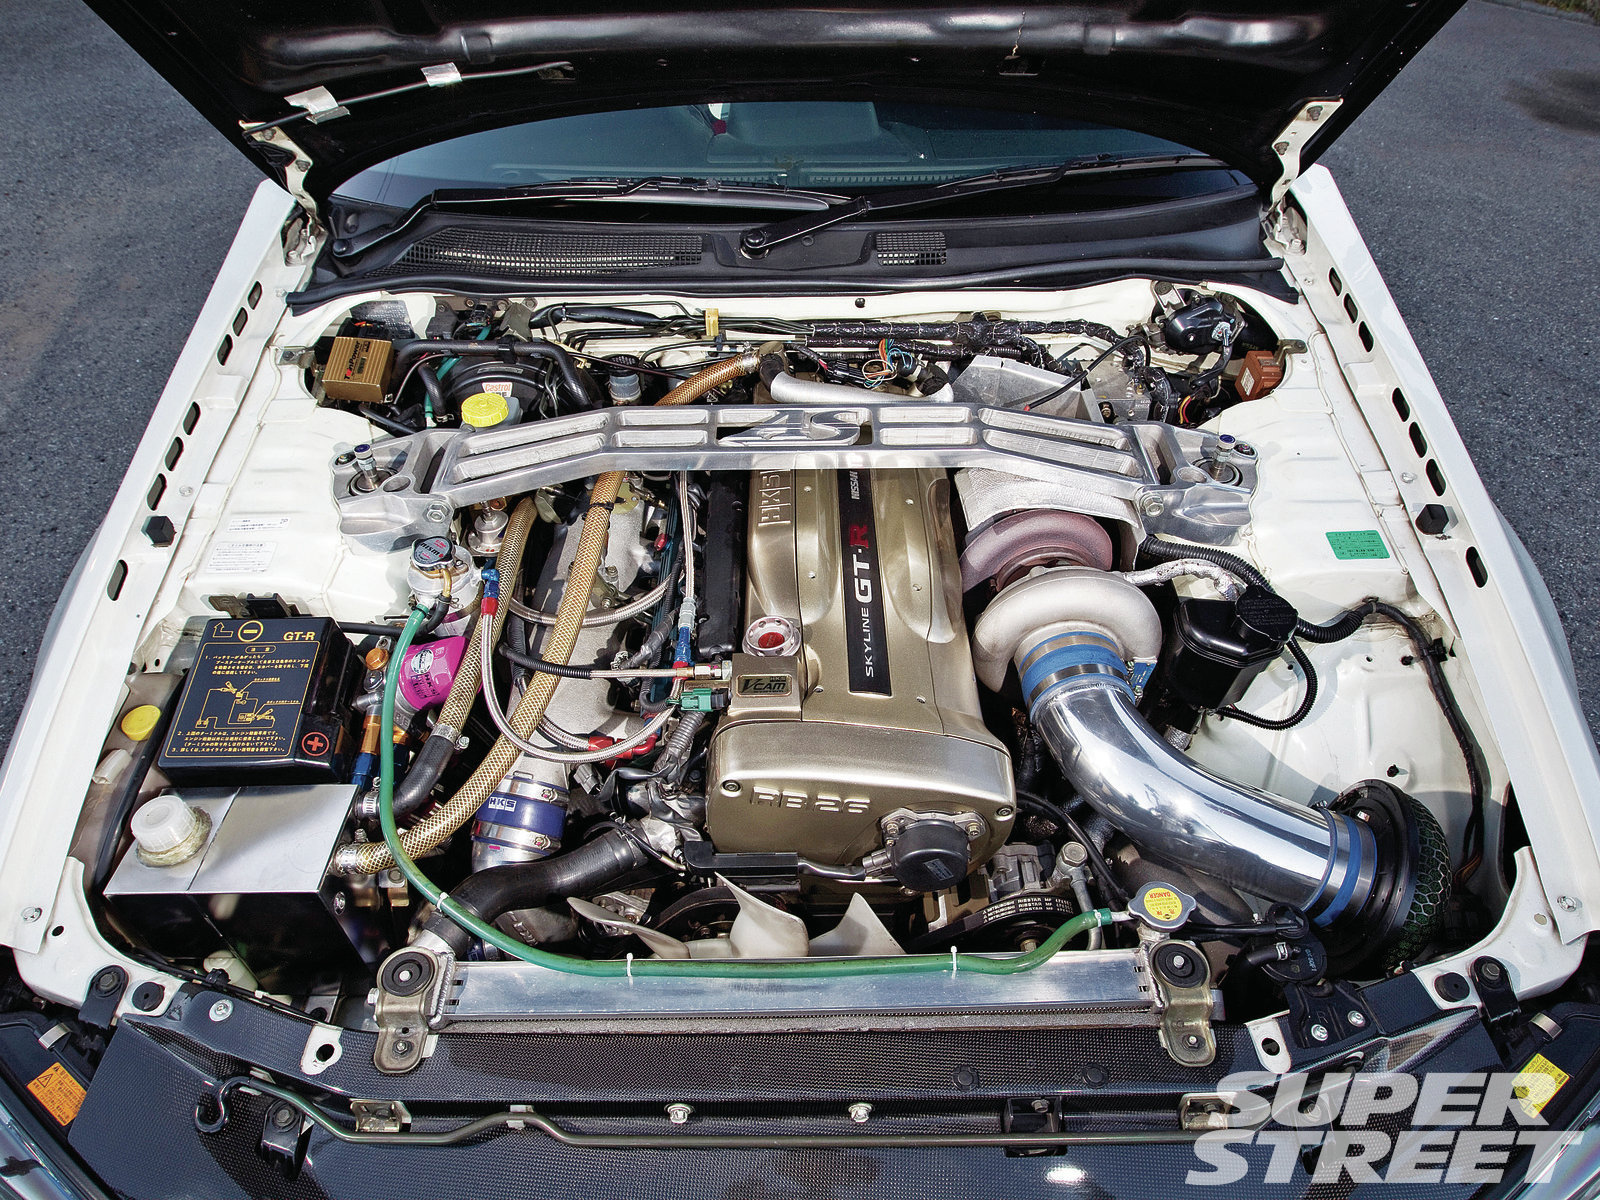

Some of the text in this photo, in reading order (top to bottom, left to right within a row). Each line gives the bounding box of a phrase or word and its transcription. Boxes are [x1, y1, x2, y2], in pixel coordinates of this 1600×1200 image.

[485, 383, 511, 392] Castrol
[849, 470, 860, 500] NISSAN
[760, 471, 786, 525] HKS
[283, 631, 316, 641] GT-R
[861, 607, 874, 677] SKYLINE
[489, 797, 516, 809] HKS
[1149, 891, 1171, 899] DANGER
